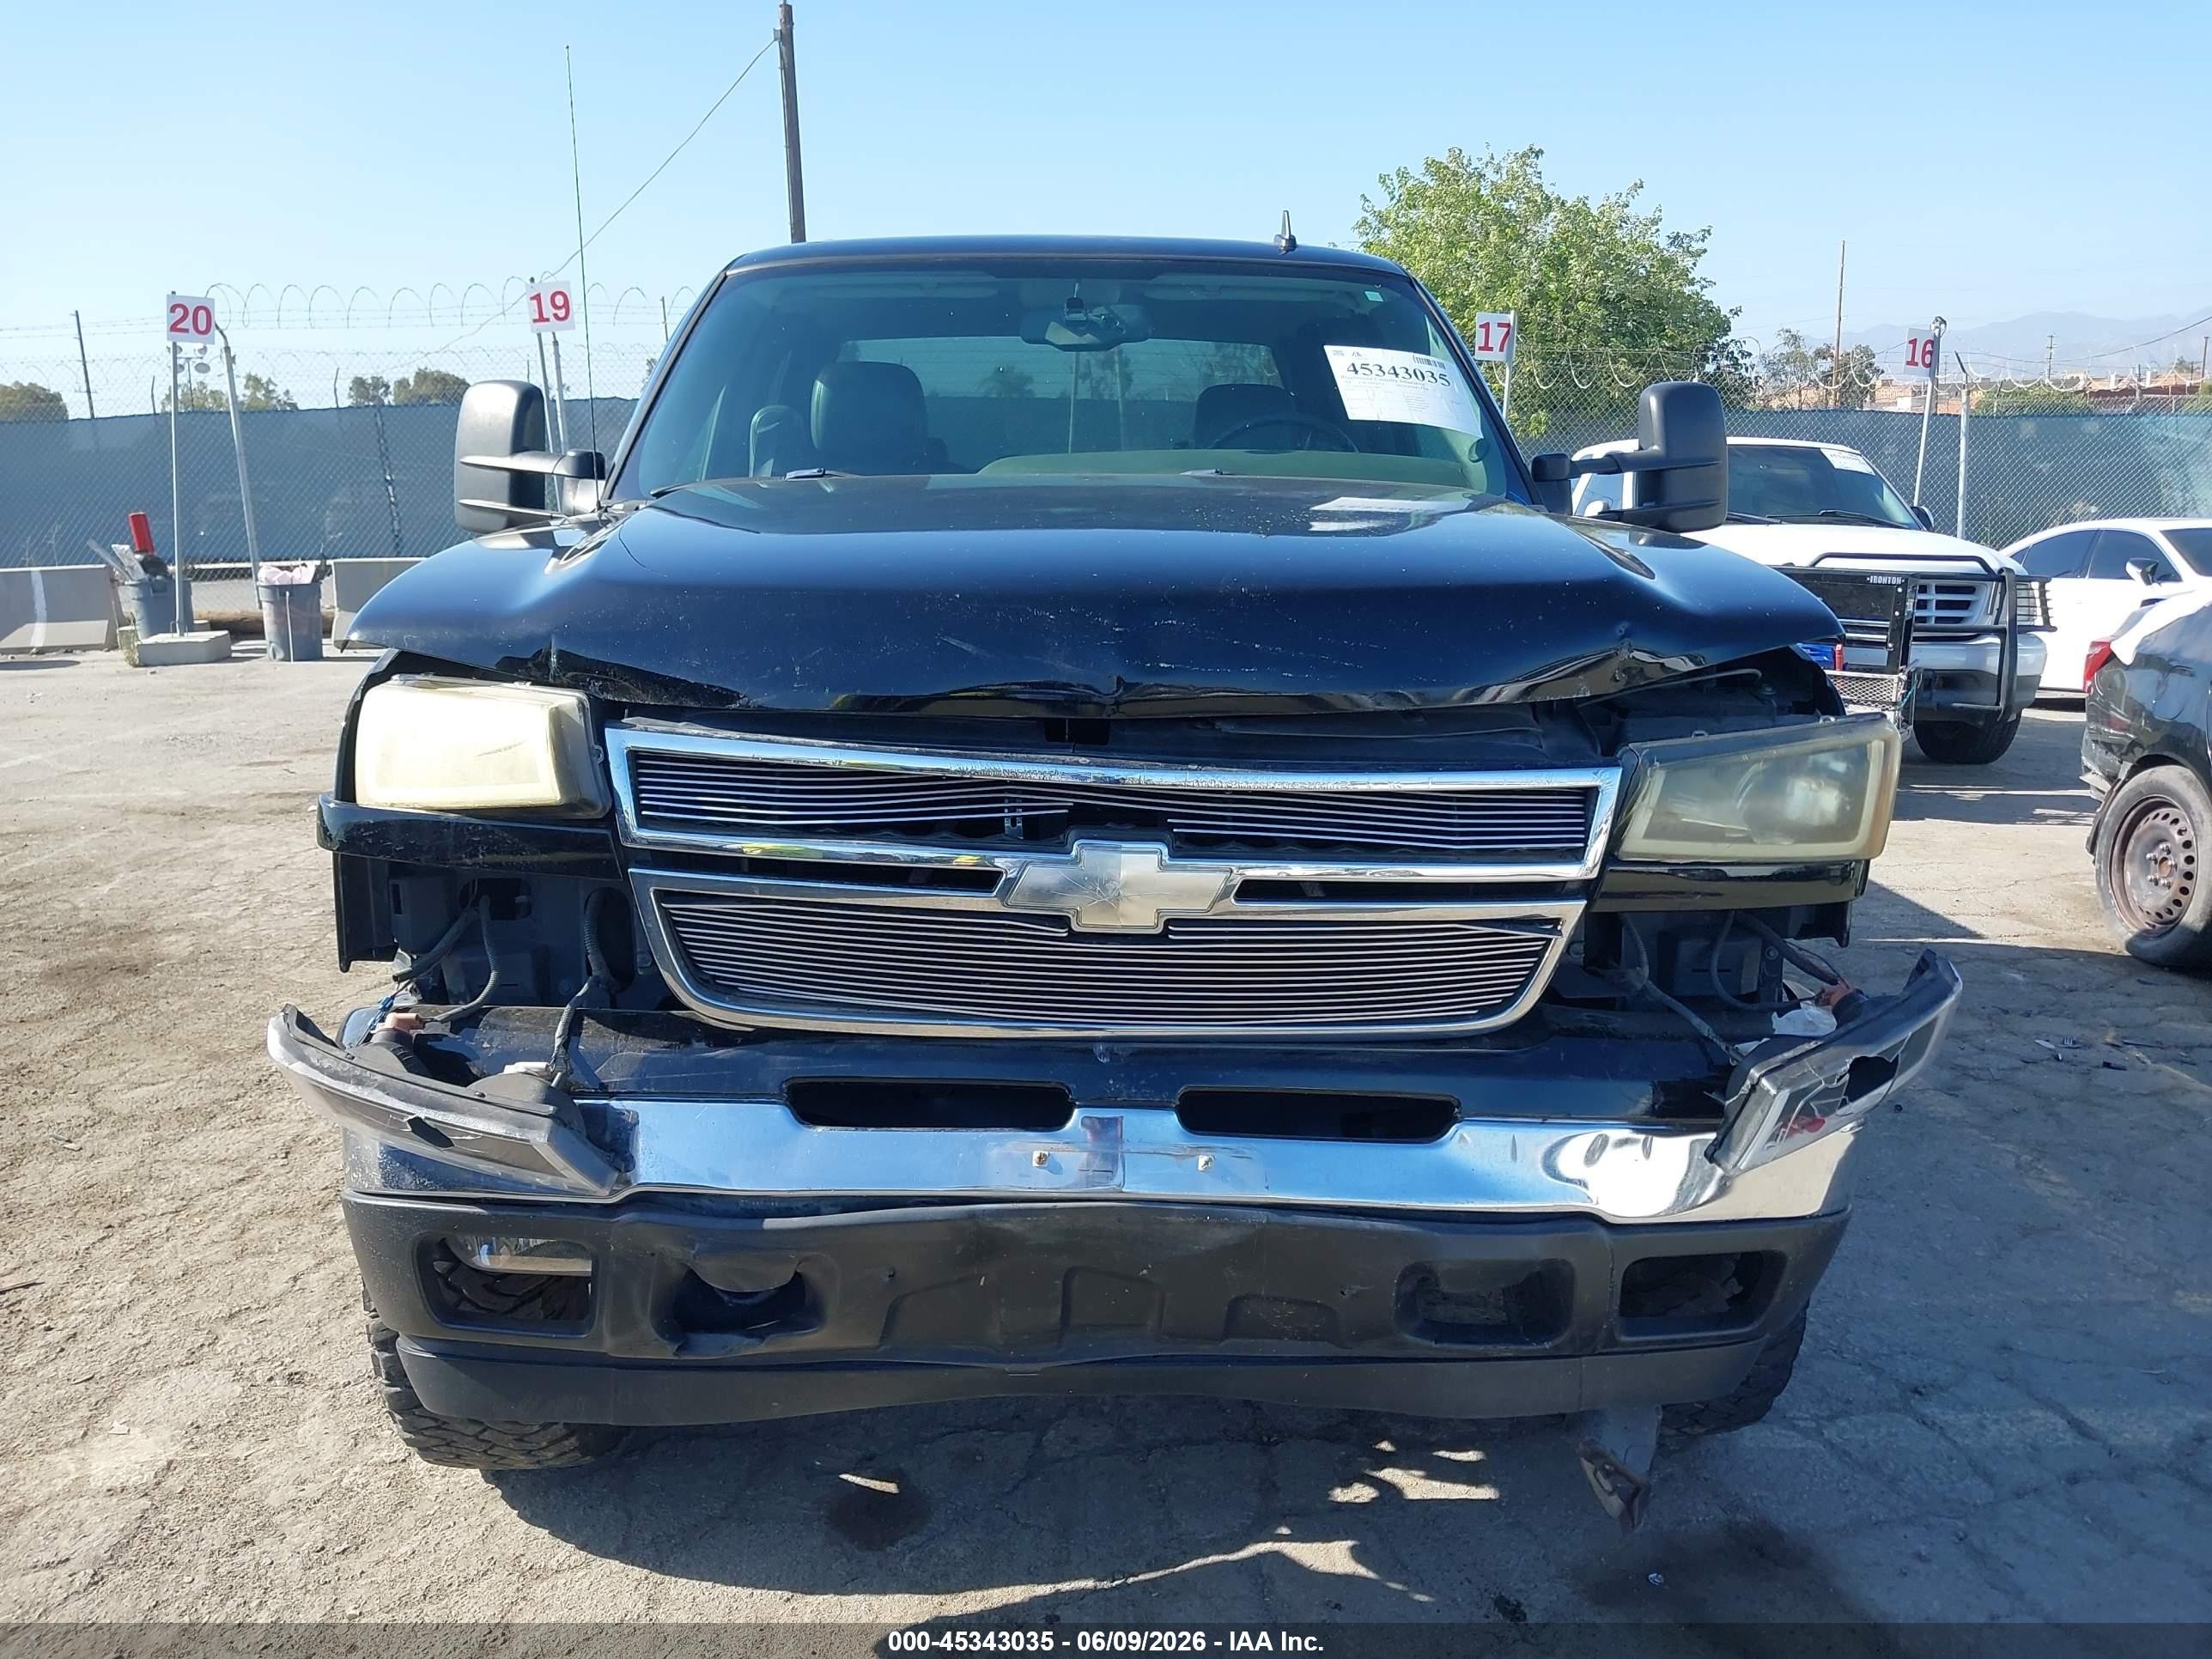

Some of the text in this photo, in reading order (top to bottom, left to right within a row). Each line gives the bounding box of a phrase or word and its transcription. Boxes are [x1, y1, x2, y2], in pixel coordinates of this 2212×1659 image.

[169, 303, 212, 336] 20
[530, 290, 570, 324] 19
[1478, 321, 1512, 353] 17
[1905, 337, 1935, 369] 16
[1346, 362, 1451, 387] 45343035
[1869, 574, 1902, 585] IRONTON
